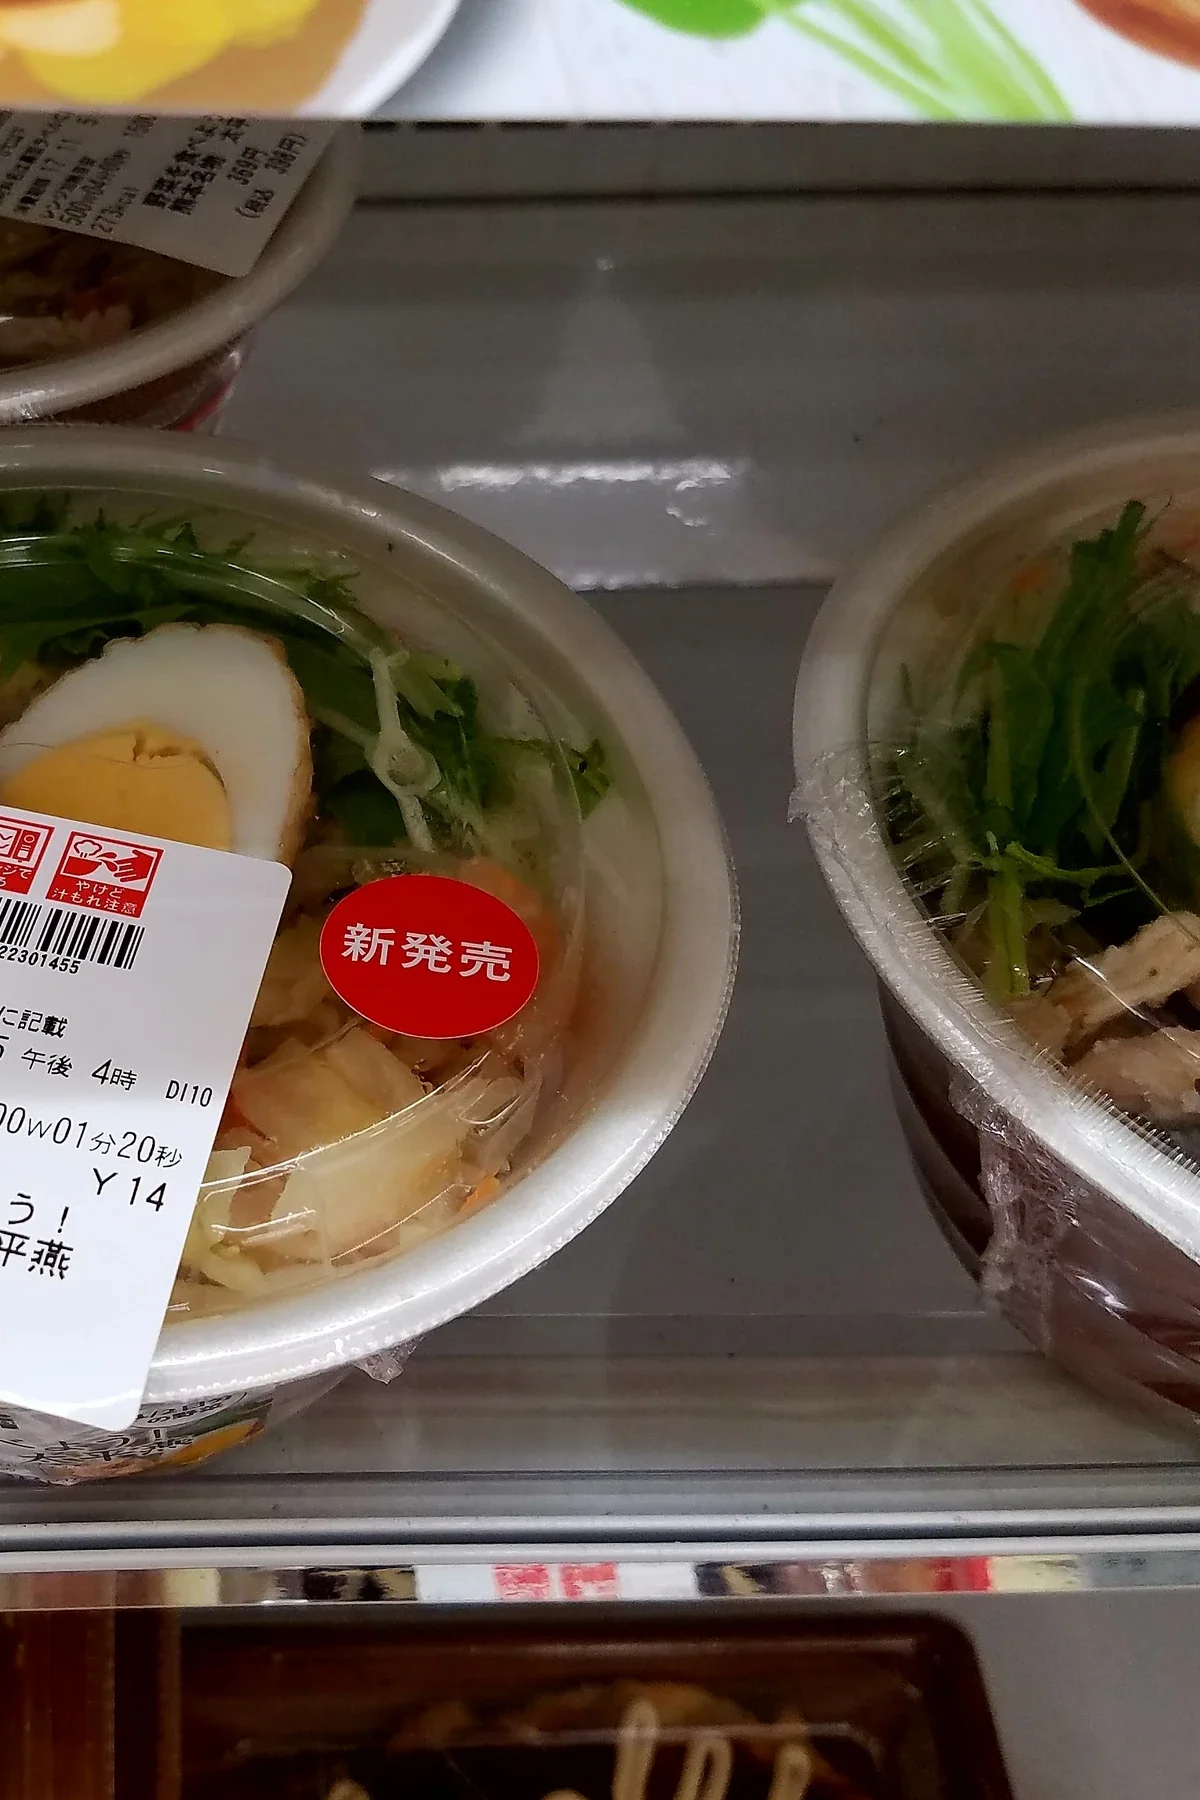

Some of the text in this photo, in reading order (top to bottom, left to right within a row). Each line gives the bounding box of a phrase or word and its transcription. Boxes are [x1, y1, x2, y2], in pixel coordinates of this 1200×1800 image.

[51, 888, 138, 915] 汁もれ注意
[76, 880, 125, 897] やけど
[341, 922, 513, 982] 新発売
